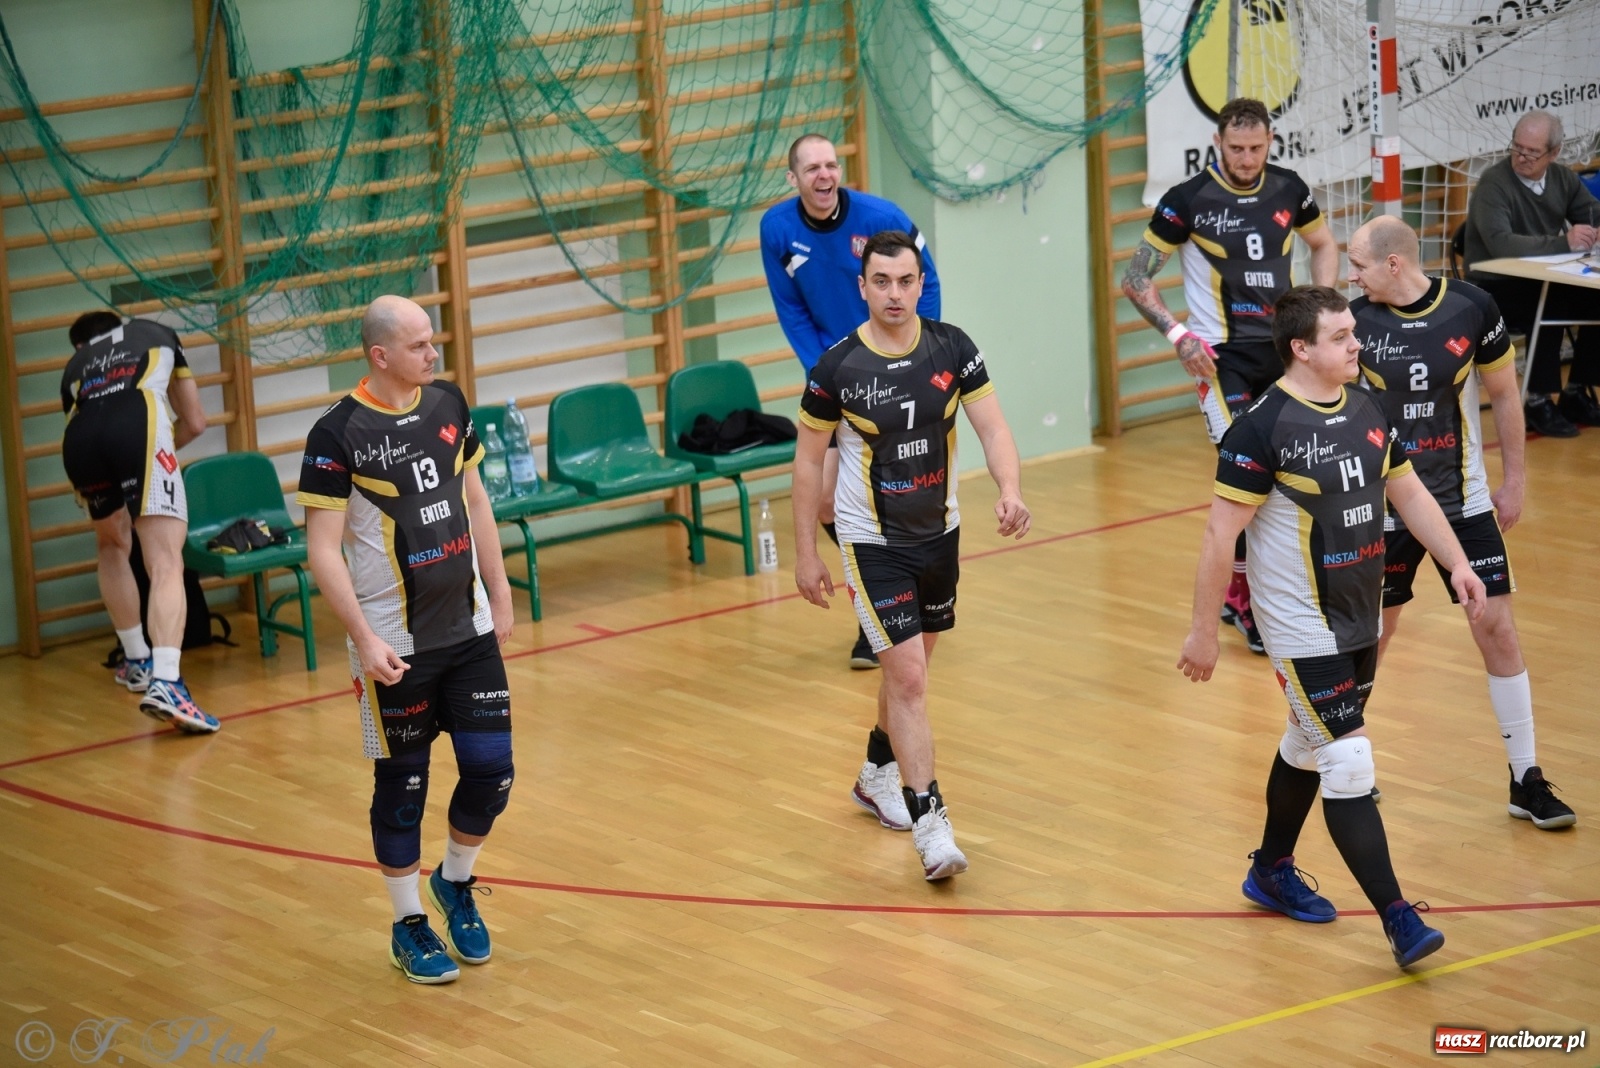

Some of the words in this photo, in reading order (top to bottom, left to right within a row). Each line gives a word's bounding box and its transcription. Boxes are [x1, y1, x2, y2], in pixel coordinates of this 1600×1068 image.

[1475, 83, 1600, 119] www.osir-ra
[1246, 233, 1264, 260] 8
[1244, 271, 1274, 288] ENTER
[1409, 362, 1428, 391] 2
[900, 400, 916, 430] 7
[1403, 402, 1434, 420] ENTER
[897, 438, 929, 460] ENTER
[412, 457, 440, 493] 13
[880, 468, 945, 492] INSTALMAG
[1338, 456, 1365, 492] 14
[163, 480, 175, 506] 4
[420, 500, 451, 525] ENTER
[1343, 503, 1373, 527] ENTER
[408, 533, 470, 567] INSTALMAG
[1323, 538, 1385, 568] INSTALMAG
[1469, 554, 1504, 567] RAVTON
[874, 590, 914, 609] INSTALMAG
[382, 701, 429, 717] INSTALMAG
